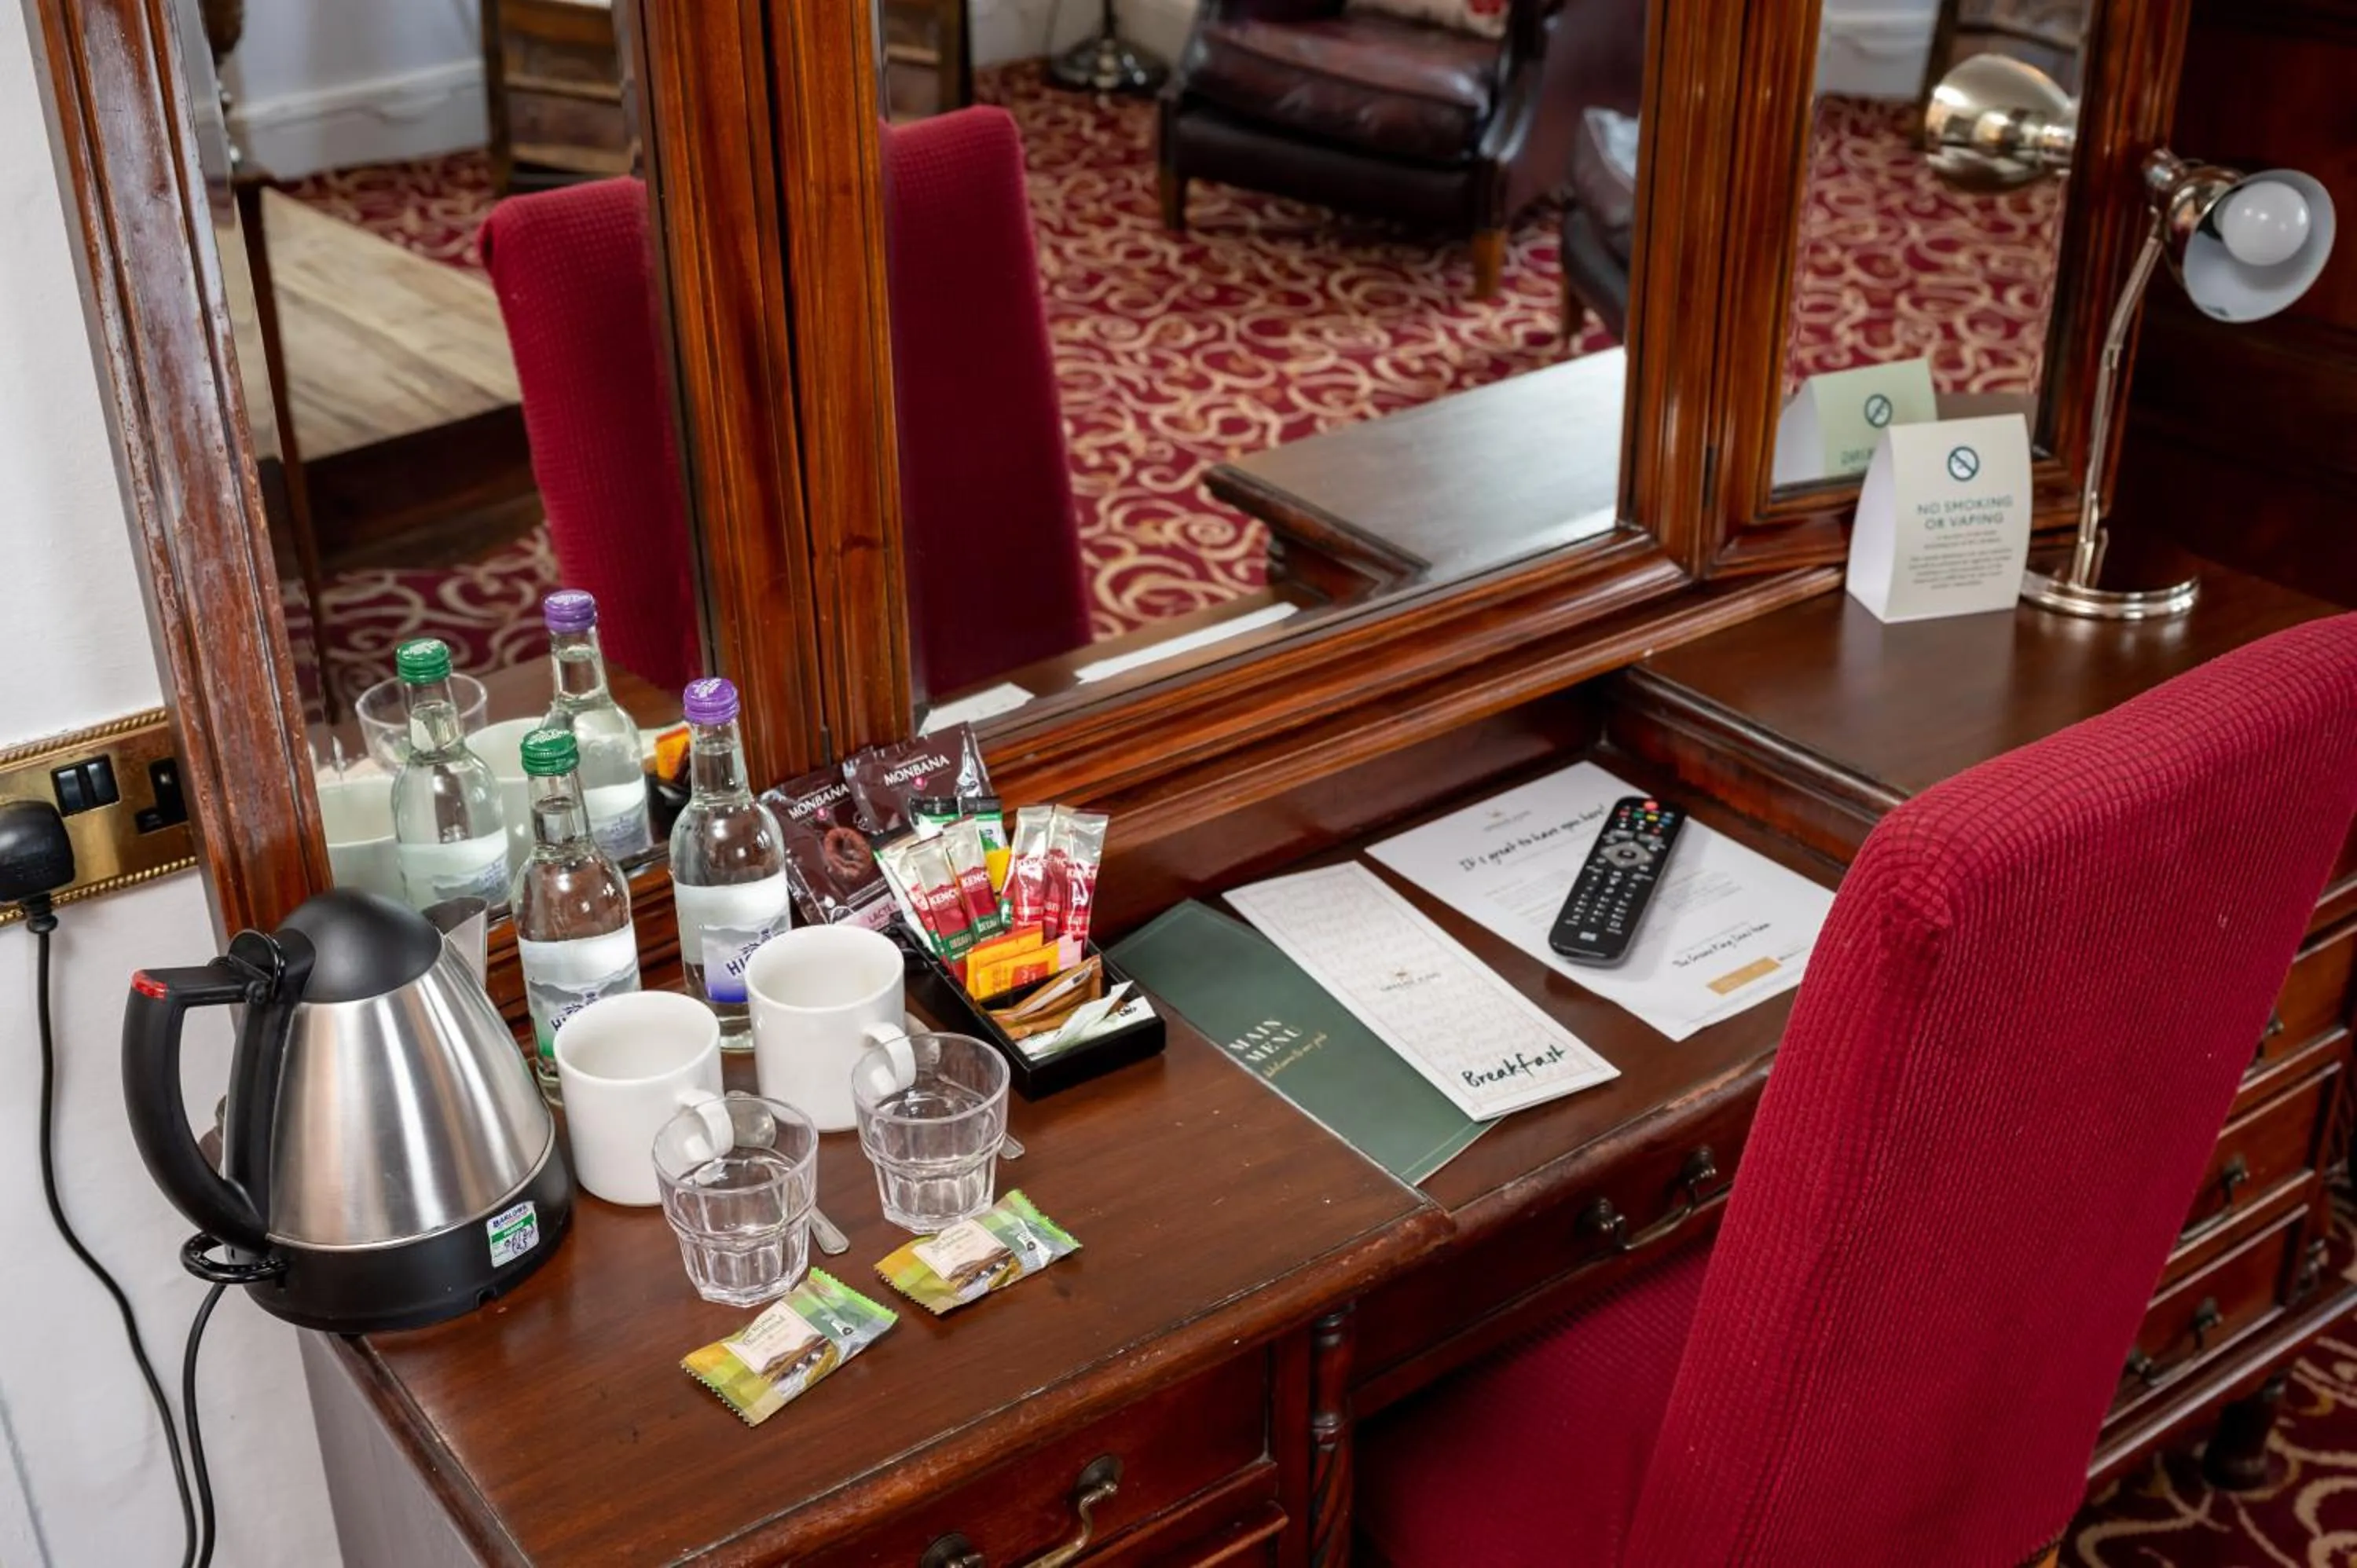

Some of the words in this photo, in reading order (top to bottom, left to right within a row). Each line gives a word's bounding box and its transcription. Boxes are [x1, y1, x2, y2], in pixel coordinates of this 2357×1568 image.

[1917, 502, 1940, 515] NO
[1944, 495, 2013, 513] SMOKING
[1924, 518, 1945, 530] OR
[1949, 512, 2004, 526] VAPING
[884, 754, 950, 786] MONBANA
[788, 782, 850, 819] MONBANA
[1229, 1020, 1281, 1050] MAIN
[1246, 1025, 1303, 1061] MENU
[1461, 1044, 1566, 1088] Breakfast
